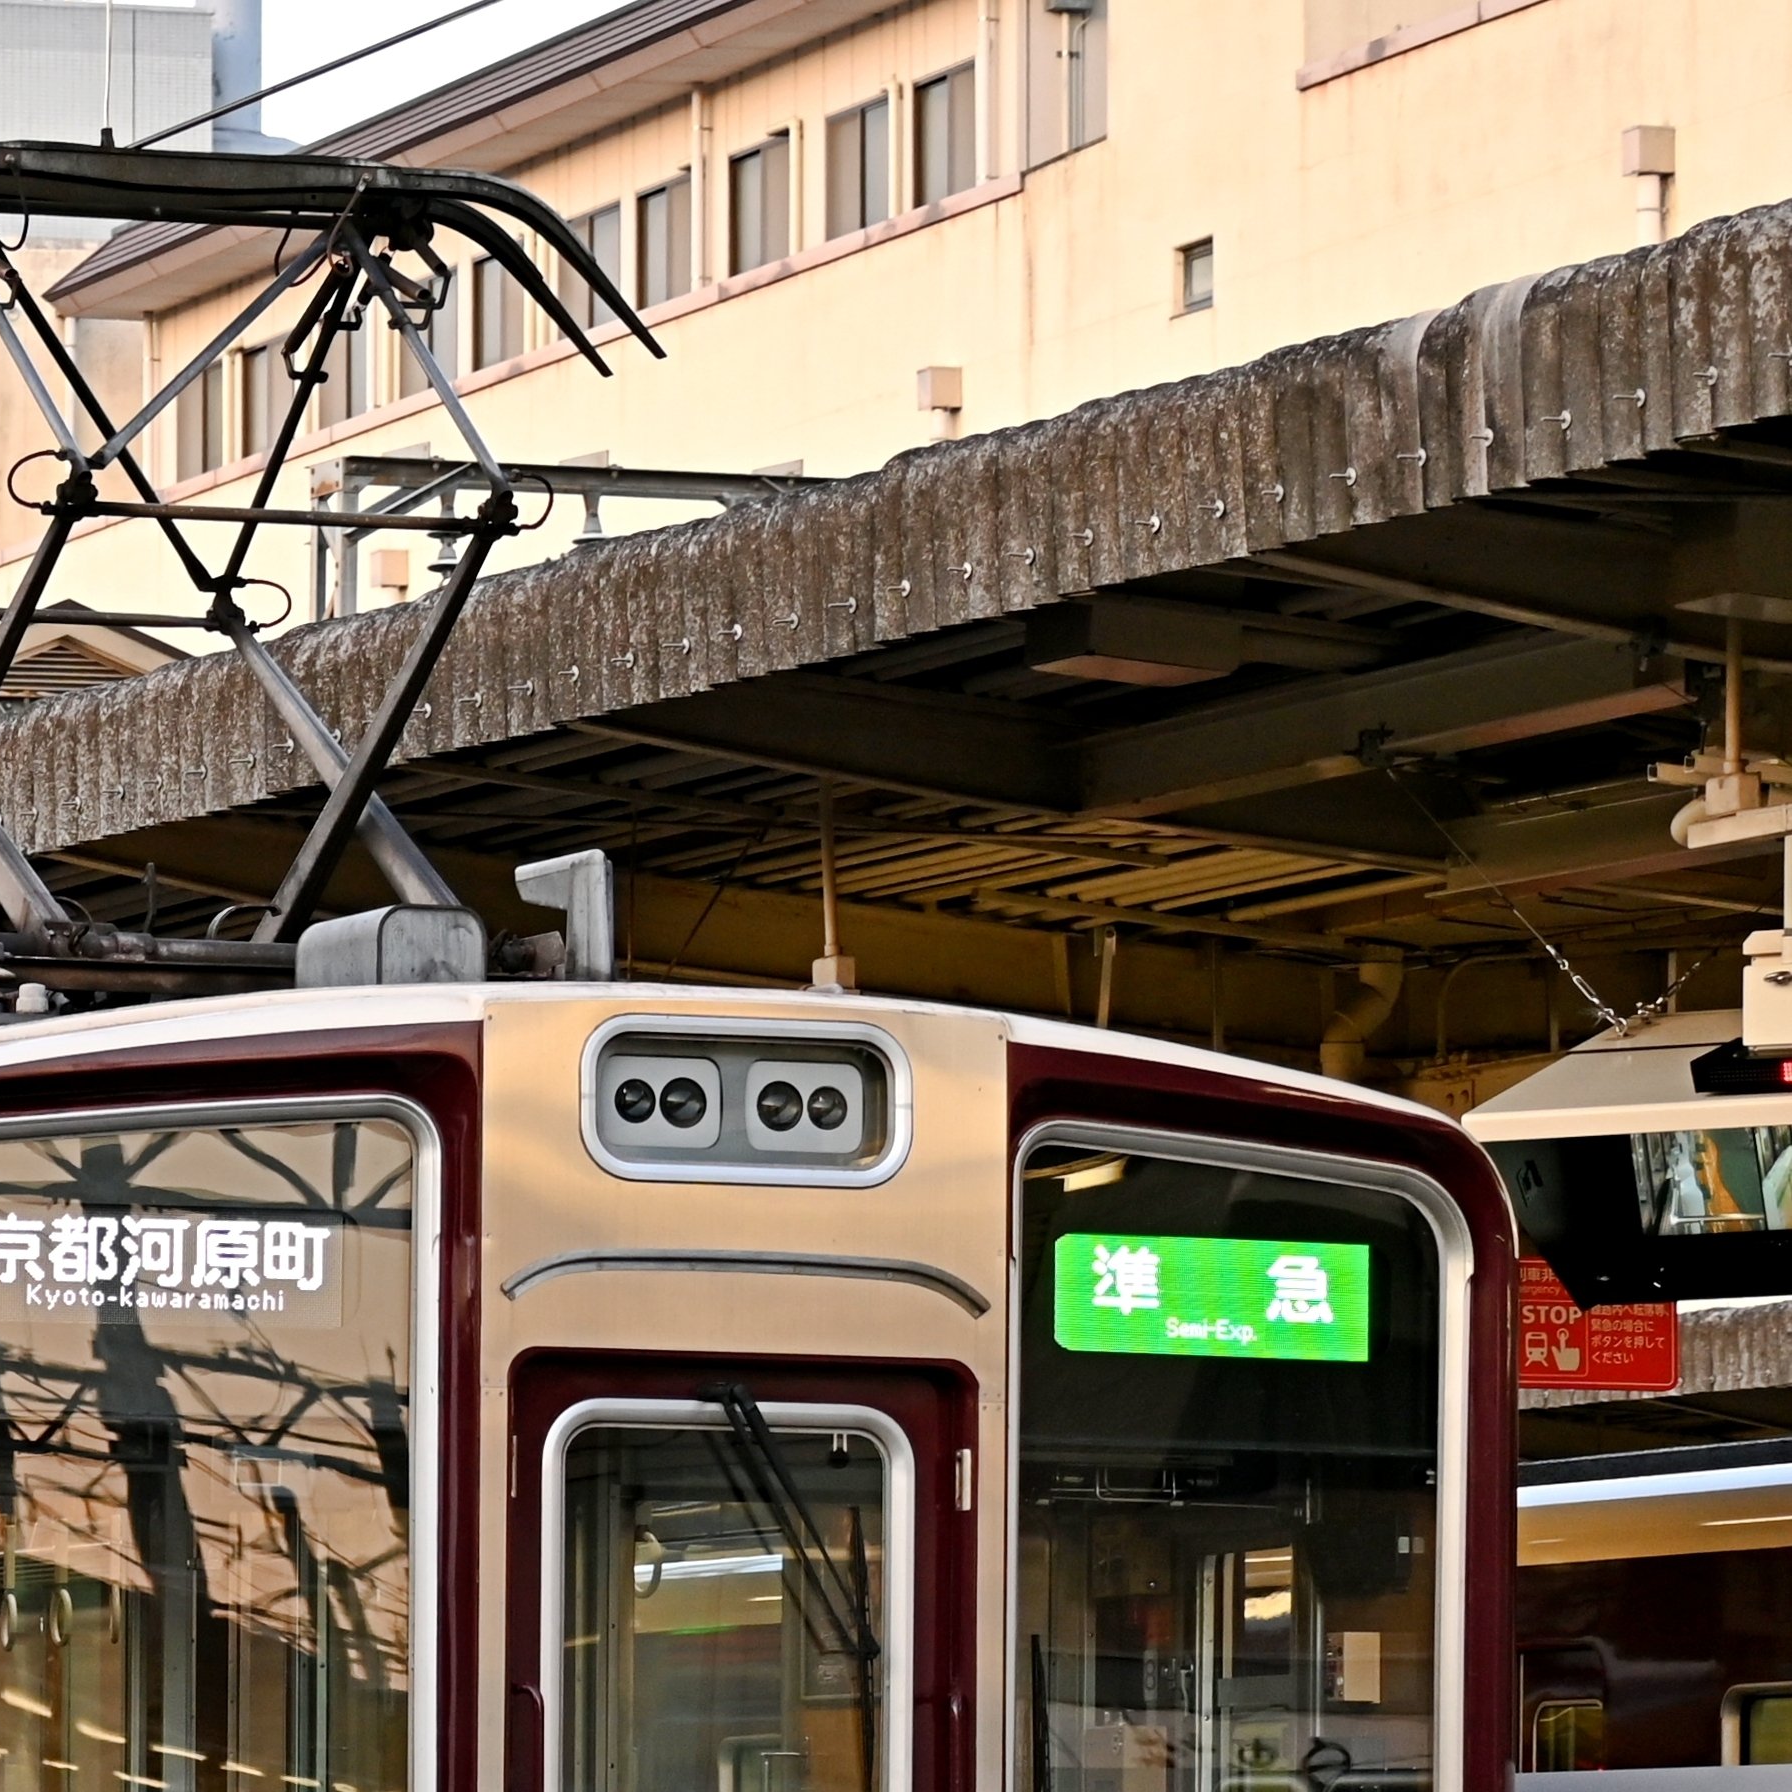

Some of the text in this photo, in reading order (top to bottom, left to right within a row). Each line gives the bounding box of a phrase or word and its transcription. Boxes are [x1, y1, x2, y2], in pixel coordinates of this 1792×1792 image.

[25, 1284, 285, 1312] Kyoto-kawaramachi
[1522, 1305, 1583, 1325] STOP
[1590, 1335, 1666, 1349] ボタンを押して
[1591, 1352, 1634, 1364] ください
